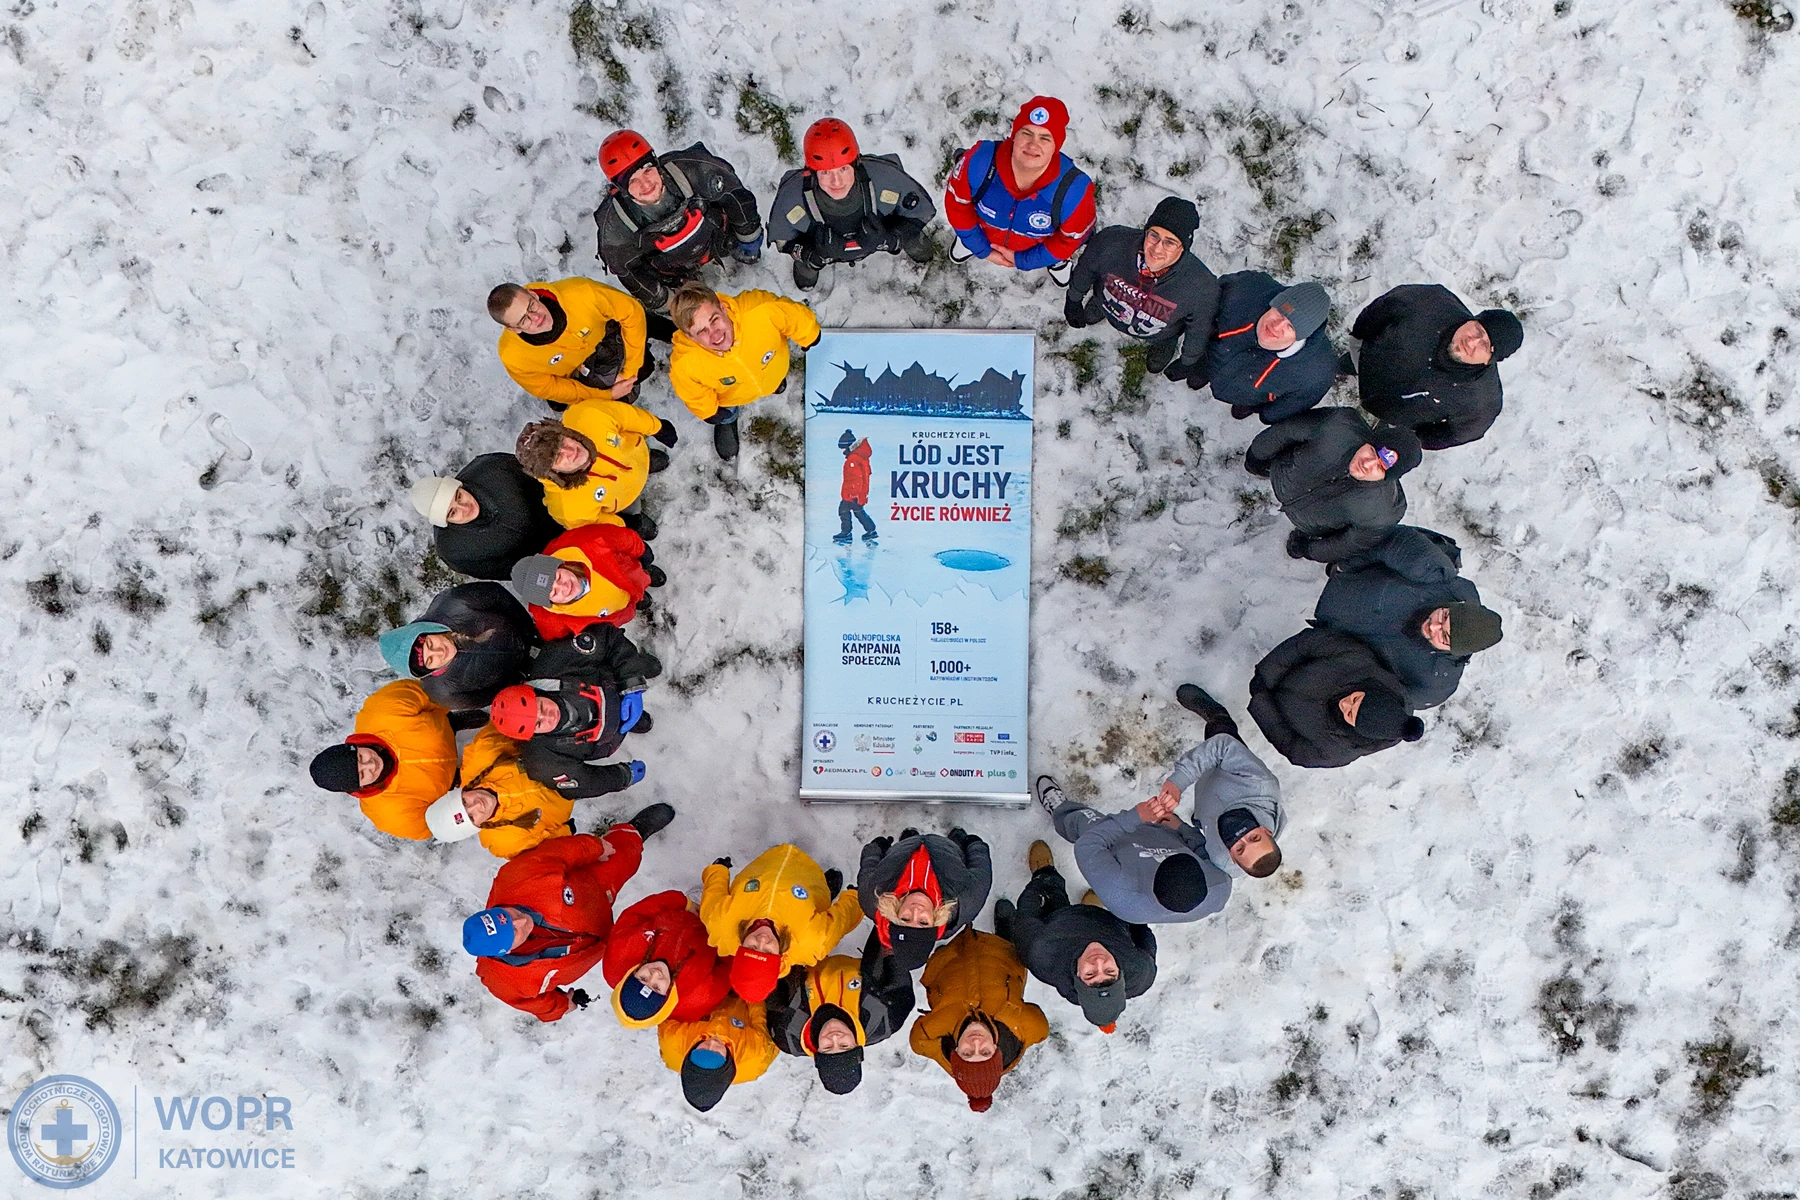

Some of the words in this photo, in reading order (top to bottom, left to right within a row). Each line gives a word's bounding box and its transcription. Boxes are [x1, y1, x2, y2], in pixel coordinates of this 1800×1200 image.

[912, 430, 991, 439] KRUCHEŻYCIE.PL
[899, 440, 941, 466] LÓD
[947, 445, 1004, 466] JEST
[890, 471, 1012, 499] KRUCHY
[890, 502, 935, 521] ŻYCIE
[939, 503, 1012, 522] RÓWNIEŻ
[931, 622, 960, 635] 158+
[842, 633, 901, 642] OGÓLNOPOLSKA
[842, 643, 901, 654] KAMPANIA
[842, 655, 901, 666] SPOŁECZNA
[931, 660, 971, 675] 1,000+
[867, 695, 964, 706] KRUCHEŻYCIE.PL
[950, 769, 984, 777] ONDUTY.PL
[987, 769, 1006, 778] plus
